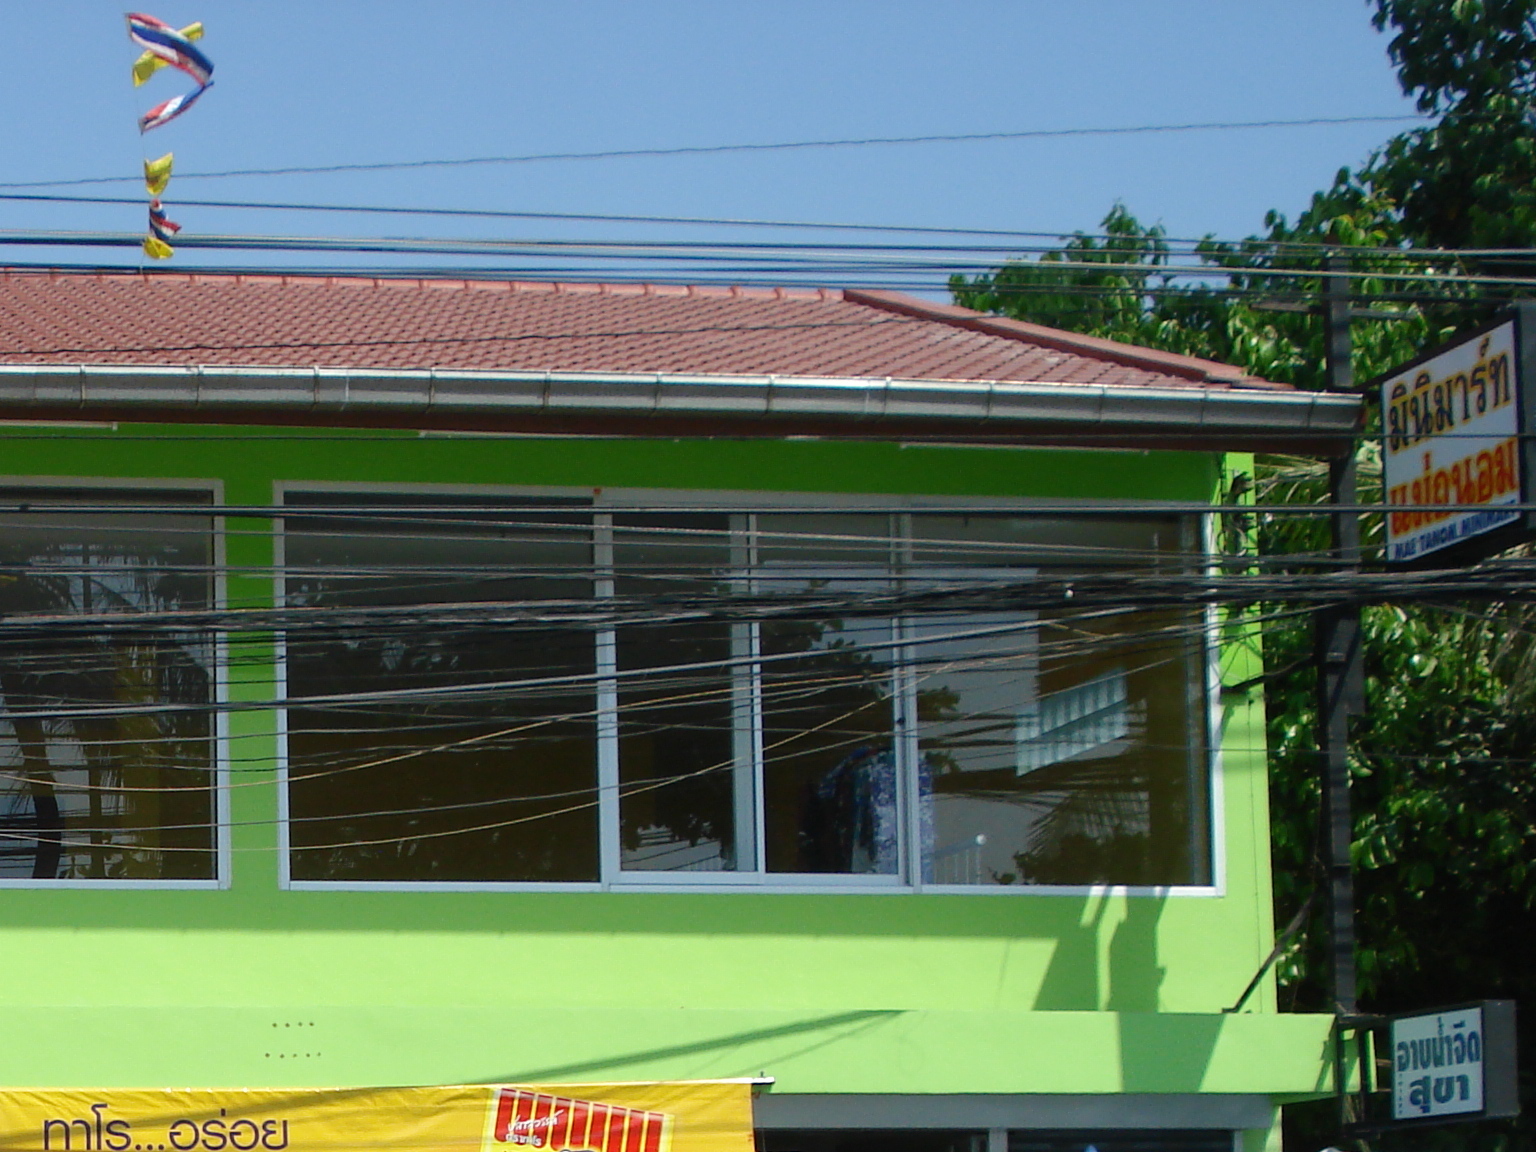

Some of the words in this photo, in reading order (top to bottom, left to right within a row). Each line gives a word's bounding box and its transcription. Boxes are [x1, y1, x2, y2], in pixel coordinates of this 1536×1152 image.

[1388, 335, 1511, 452] มินิมาร์ท
[1396, 1016, 1482, 1072] อาบน้ำจืด
[1409, 1073, 1471, 1114] สุขา
